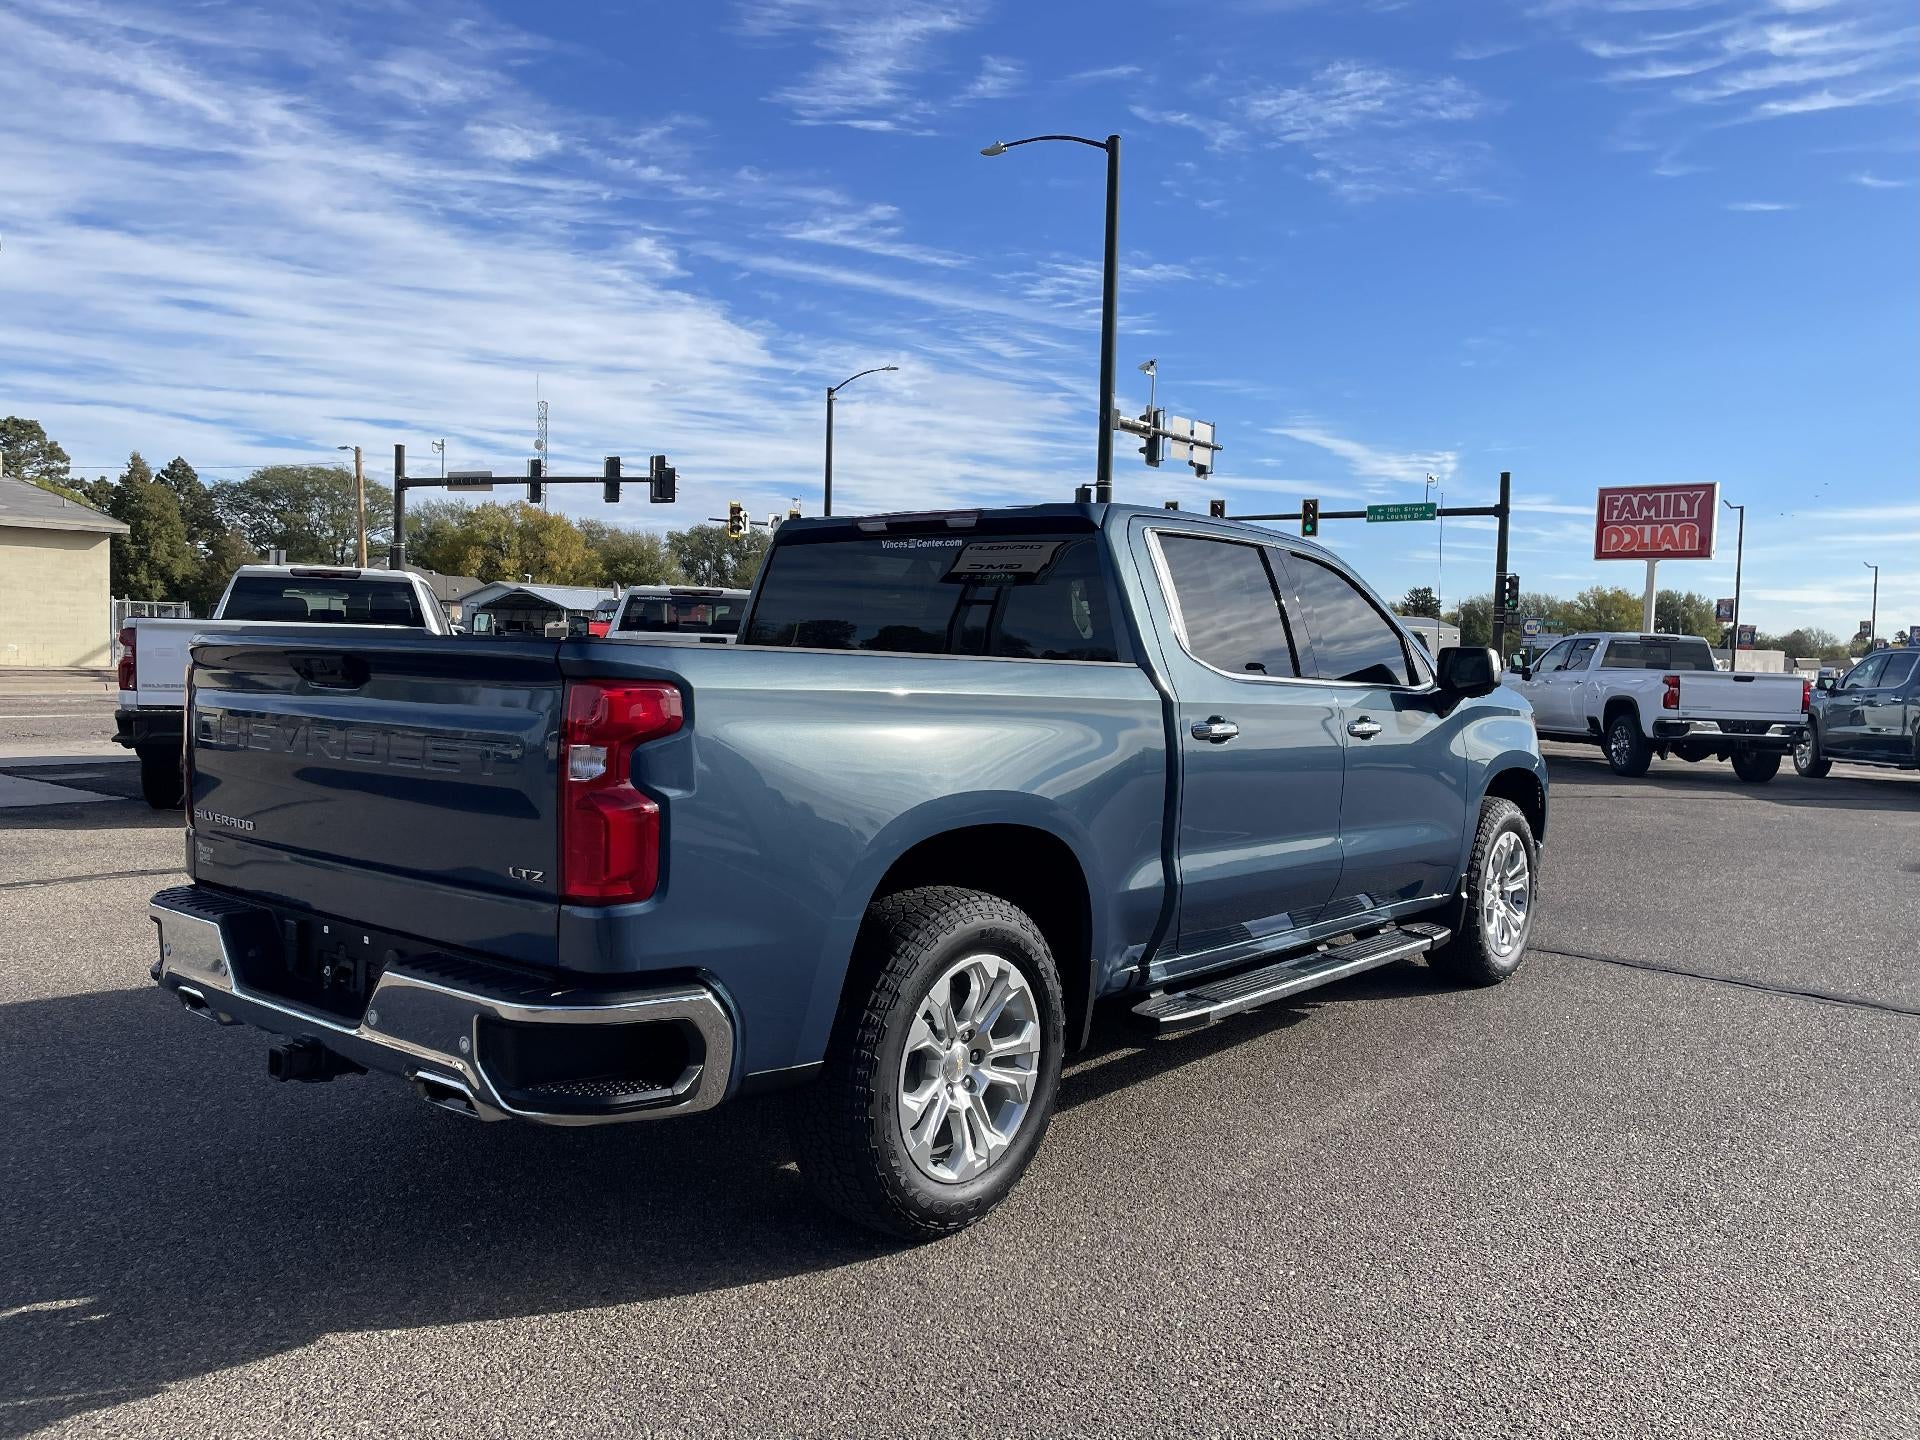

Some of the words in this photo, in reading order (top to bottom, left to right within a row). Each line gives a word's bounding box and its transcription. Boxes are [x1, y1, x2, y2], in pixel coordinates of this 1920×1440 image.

[1386, 513, 1412, 521] Lounge
[1604, 490, 1705, 521] FAMILY
[1602, 523, 1699, 553] DOLLAR
[197, 711, 512, 776] CHEVROLET
[194, 808, 255, 831] SILVERADO
[508, 866, 544, 884] LTZ
